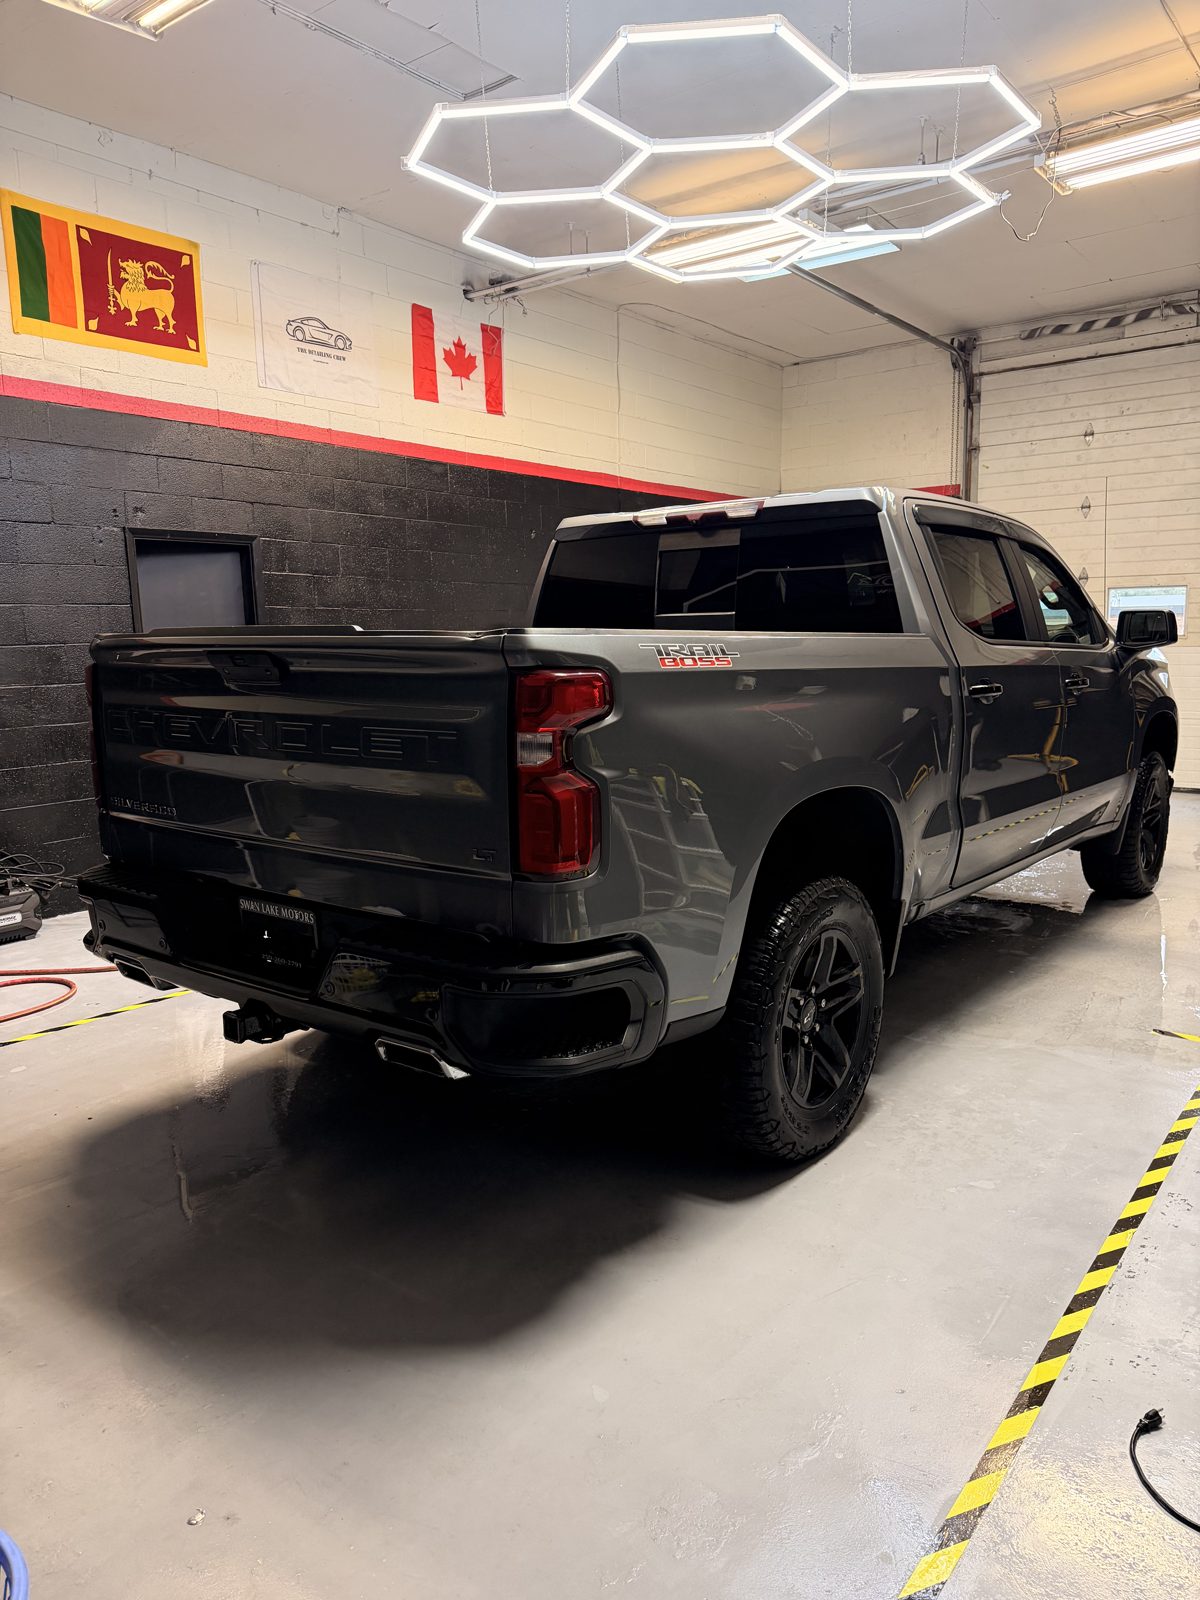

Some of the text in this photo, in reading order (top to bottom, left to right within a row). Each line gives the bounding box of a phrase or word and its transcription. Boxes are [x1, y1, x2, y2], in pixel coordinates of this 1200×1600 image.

[308, 349, 332, 359] DETAILING
[638, 643, 740, 657] TRAIL
[659, 656, 733, 668] BOSS
[104, 706, 458, 764] CHEVROLET
[240, 898, 314, 923] SWAN LAKE MOTORS
